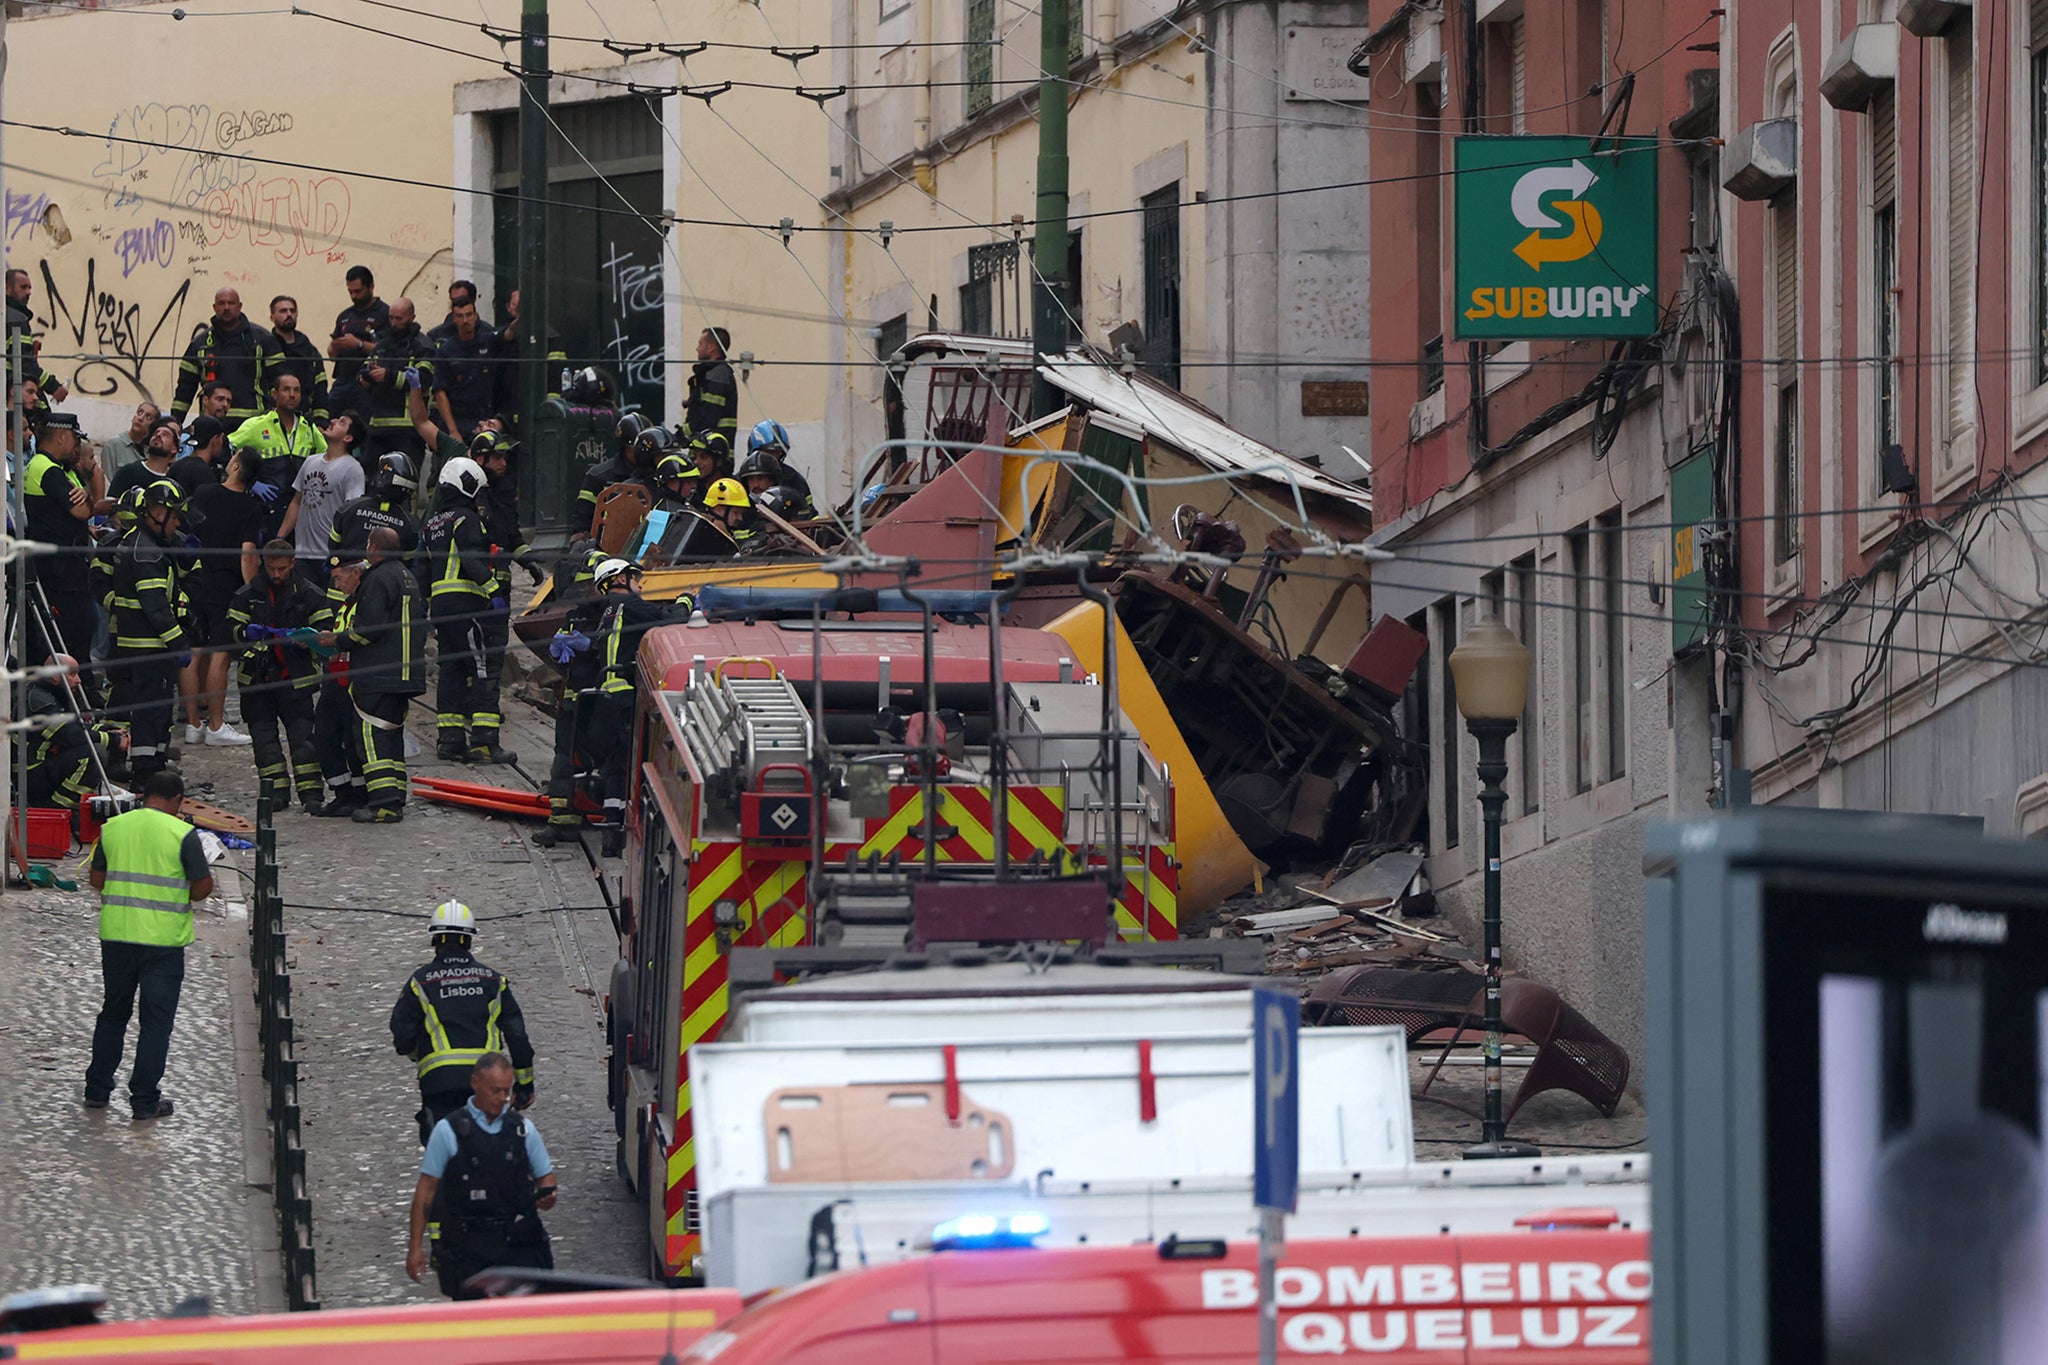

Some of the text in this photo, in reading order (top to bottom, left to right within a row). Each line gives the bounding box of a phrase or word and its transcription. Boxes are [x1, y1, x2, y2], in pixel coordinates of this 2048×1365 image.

[1464, 284, 1651, 321] SUBWAY
[356, 508, 405, 527] SAPADORES
[425, 967, 494, 982] SAPADORES
[439, 985, 485, 999] Lisboa
[1264, 1003, 1290, 1148] P
[1282, 1306, 1642, 1355] QUELUZ
